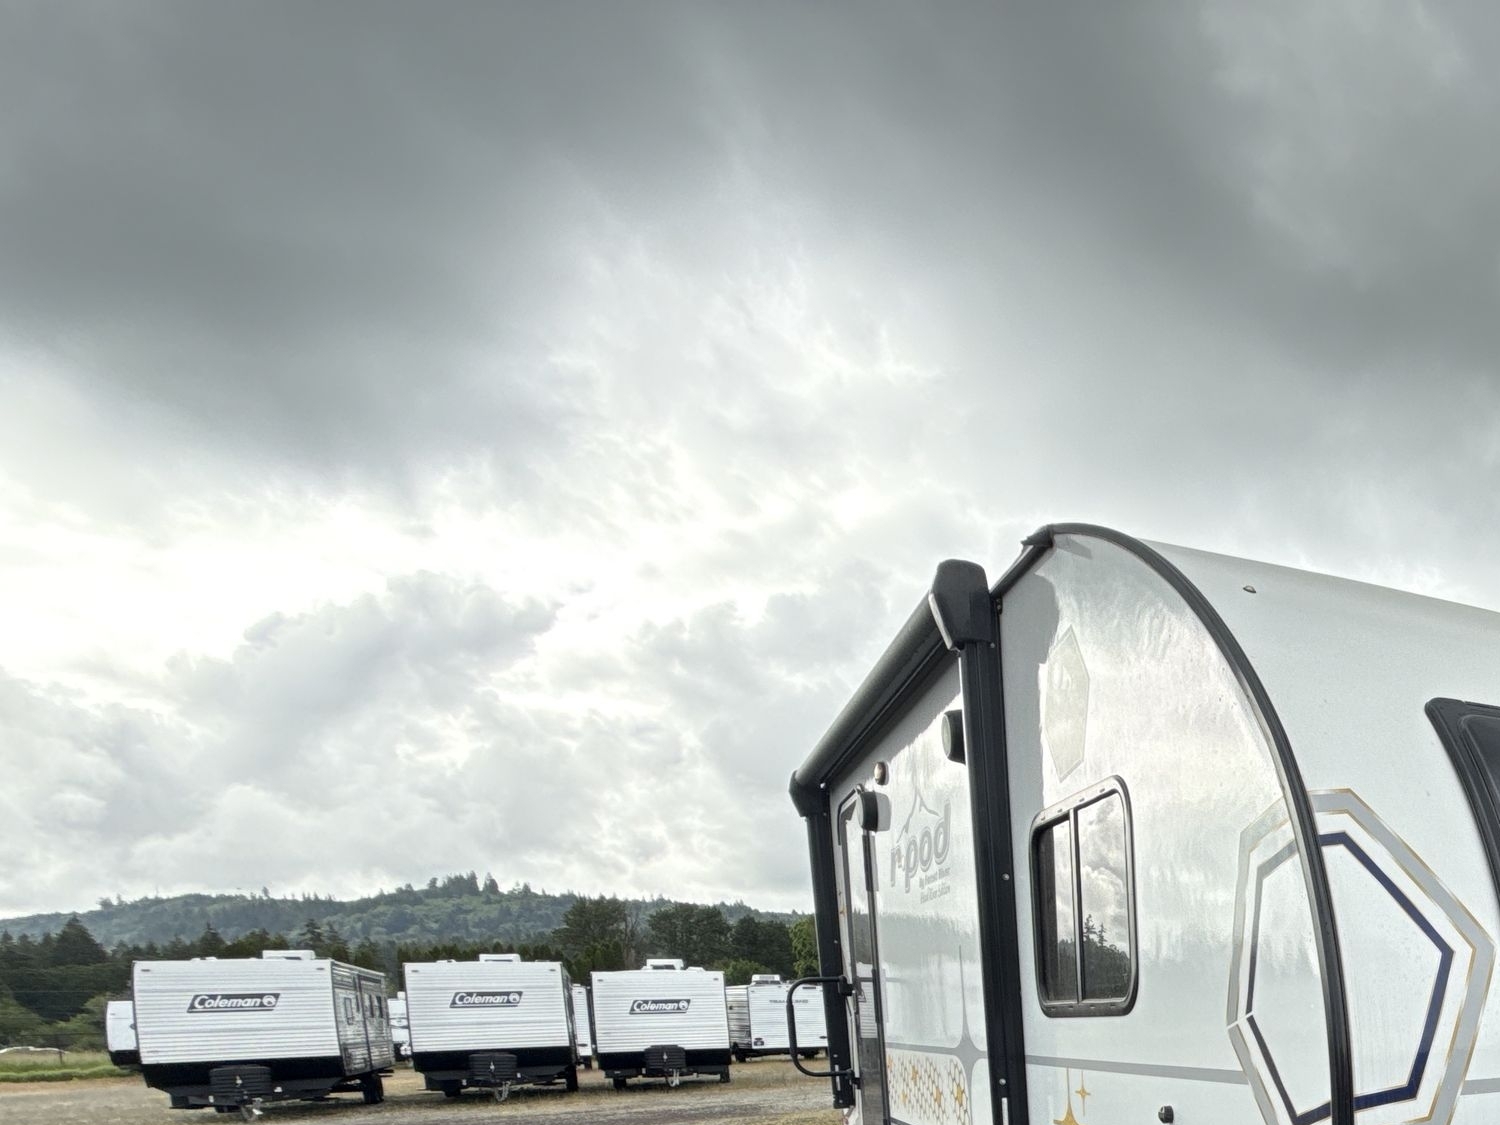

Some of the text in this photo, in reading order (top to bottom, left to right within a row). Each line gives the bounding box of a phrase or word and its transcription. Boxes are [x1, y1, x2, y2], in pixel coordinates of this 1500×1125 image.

[194, 995, 261, 1009] Coleman
[455, 993, 508, 1005] Coleman
[633, 1001, 678, 1011] Coleman
